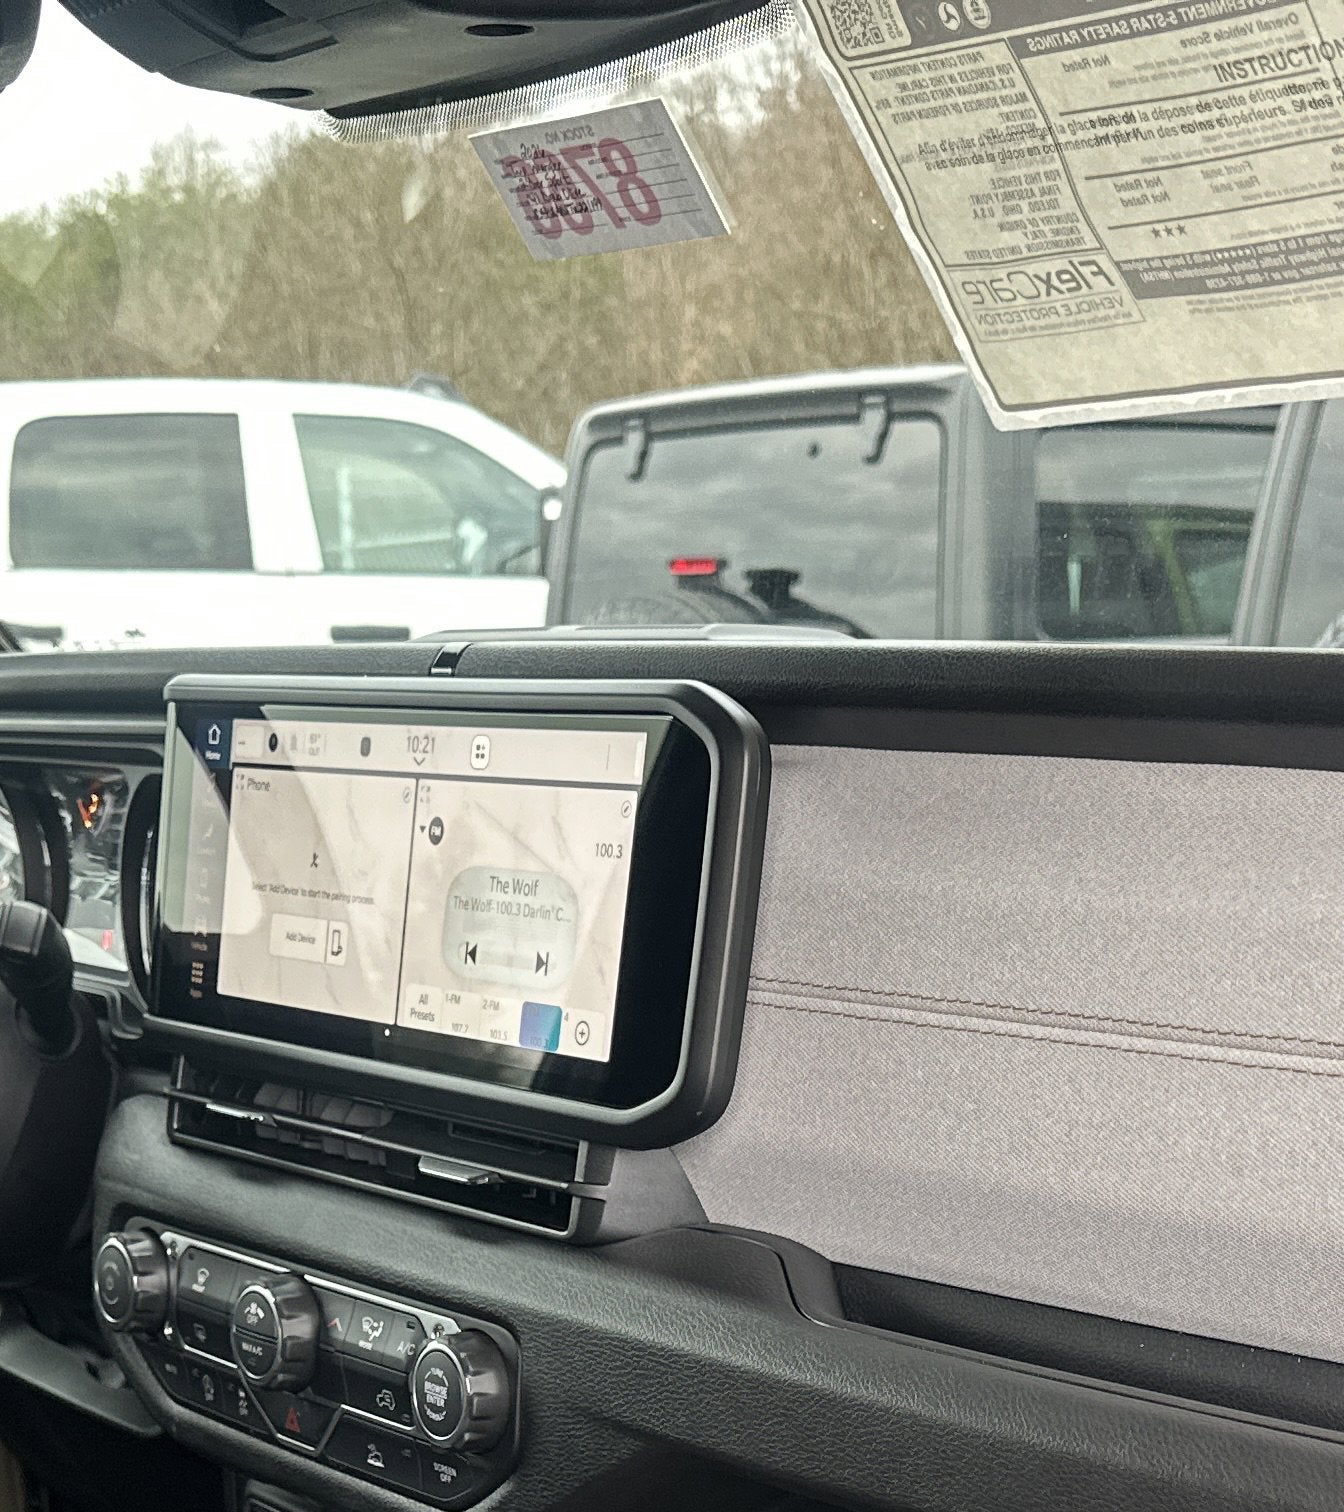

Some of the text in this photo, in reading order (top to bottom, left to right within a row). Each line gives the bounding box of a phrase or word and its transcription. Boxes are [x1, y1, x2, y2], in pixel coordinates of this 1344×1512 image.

[1137, 106, 1150, 121] la
[1157, 122, 1180, 139] des
[407, 735, 435, 755] 10:21
[247, 778, 270, 792] Phone
[429, 825, 443, 838] FM
[595, 841, 623, 859] 100.3
[490, 875, 540, 898] The Wolf
[453, 895, 470, 912] The
[418, 993, 429, 1006] All
[410, 1007, 436, 1023] Presets
[397, 1340, 416, 1357] A/C
[433, 1462, 457, 1477] SCREEN
[440, 1472, 452, 1484] OFF
